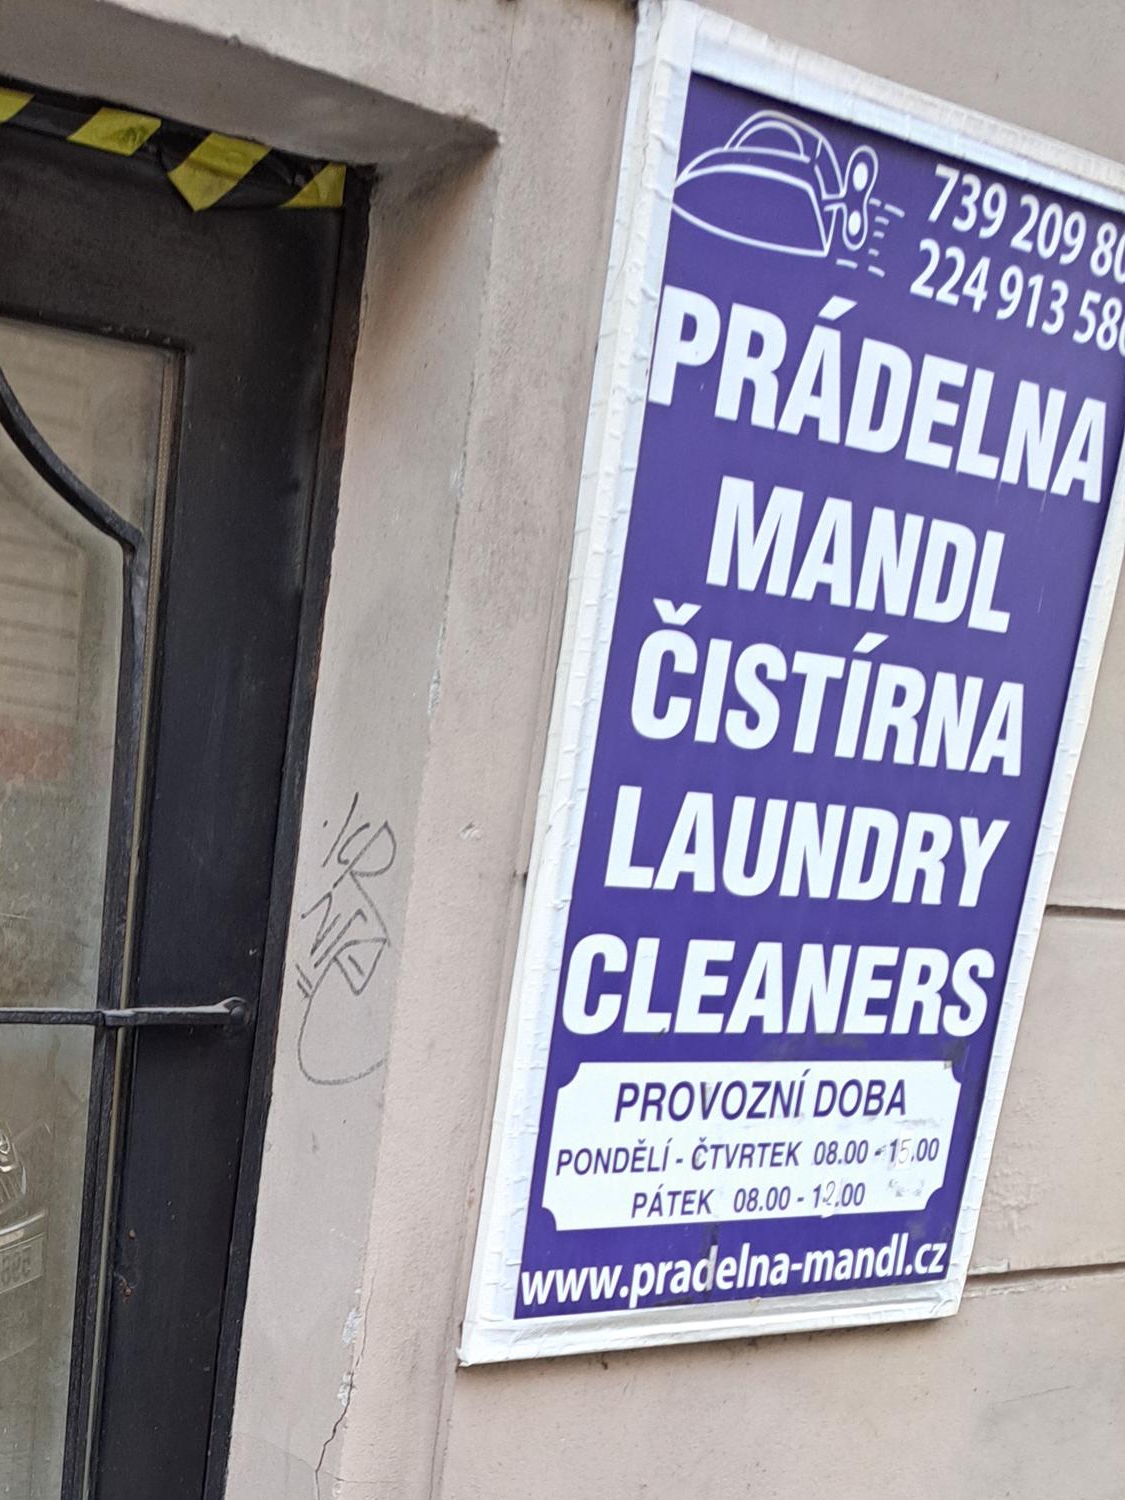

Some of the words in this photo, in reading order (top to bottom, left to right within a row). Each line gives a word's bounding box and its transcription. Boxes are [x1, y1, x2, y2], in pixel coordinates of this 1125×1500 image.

[928, 163, 1008, 240] 739
[1010, 193, 1087, 266] 209
[909, 238, 991, 314] 224
[995, 264, 1069, 336] 913
[648, 284, 1107, 504] PRÁDELNA
[706, 475, 1011, 634] MANDL
[630, 597, 1025, 777] ČISTÍRNA
[604, 785, 1010, 908] LAUNDRY
[562, 933, 996, 1037] CLEANERS
[613, 1069, 811, 1124] PROVOZNÍ
[813, 1079, 907, 1117] DOBA
[555, 1138, 674, 1177] PONDĚLÍ
[691, 1137, 803, 1171] ČTVRTEK
[813, 1139, 869, 1167] 08.00
[889, 1137, 940, 1165] 15.00
[631, 1185, 715, 1219] PÁTEK
[733, 1185, 792, 1214] 08.00
[813, 1180, 866, 1208] 12.00
[520, 1232, 948, 1309] www.pradelna-mandl.cz
